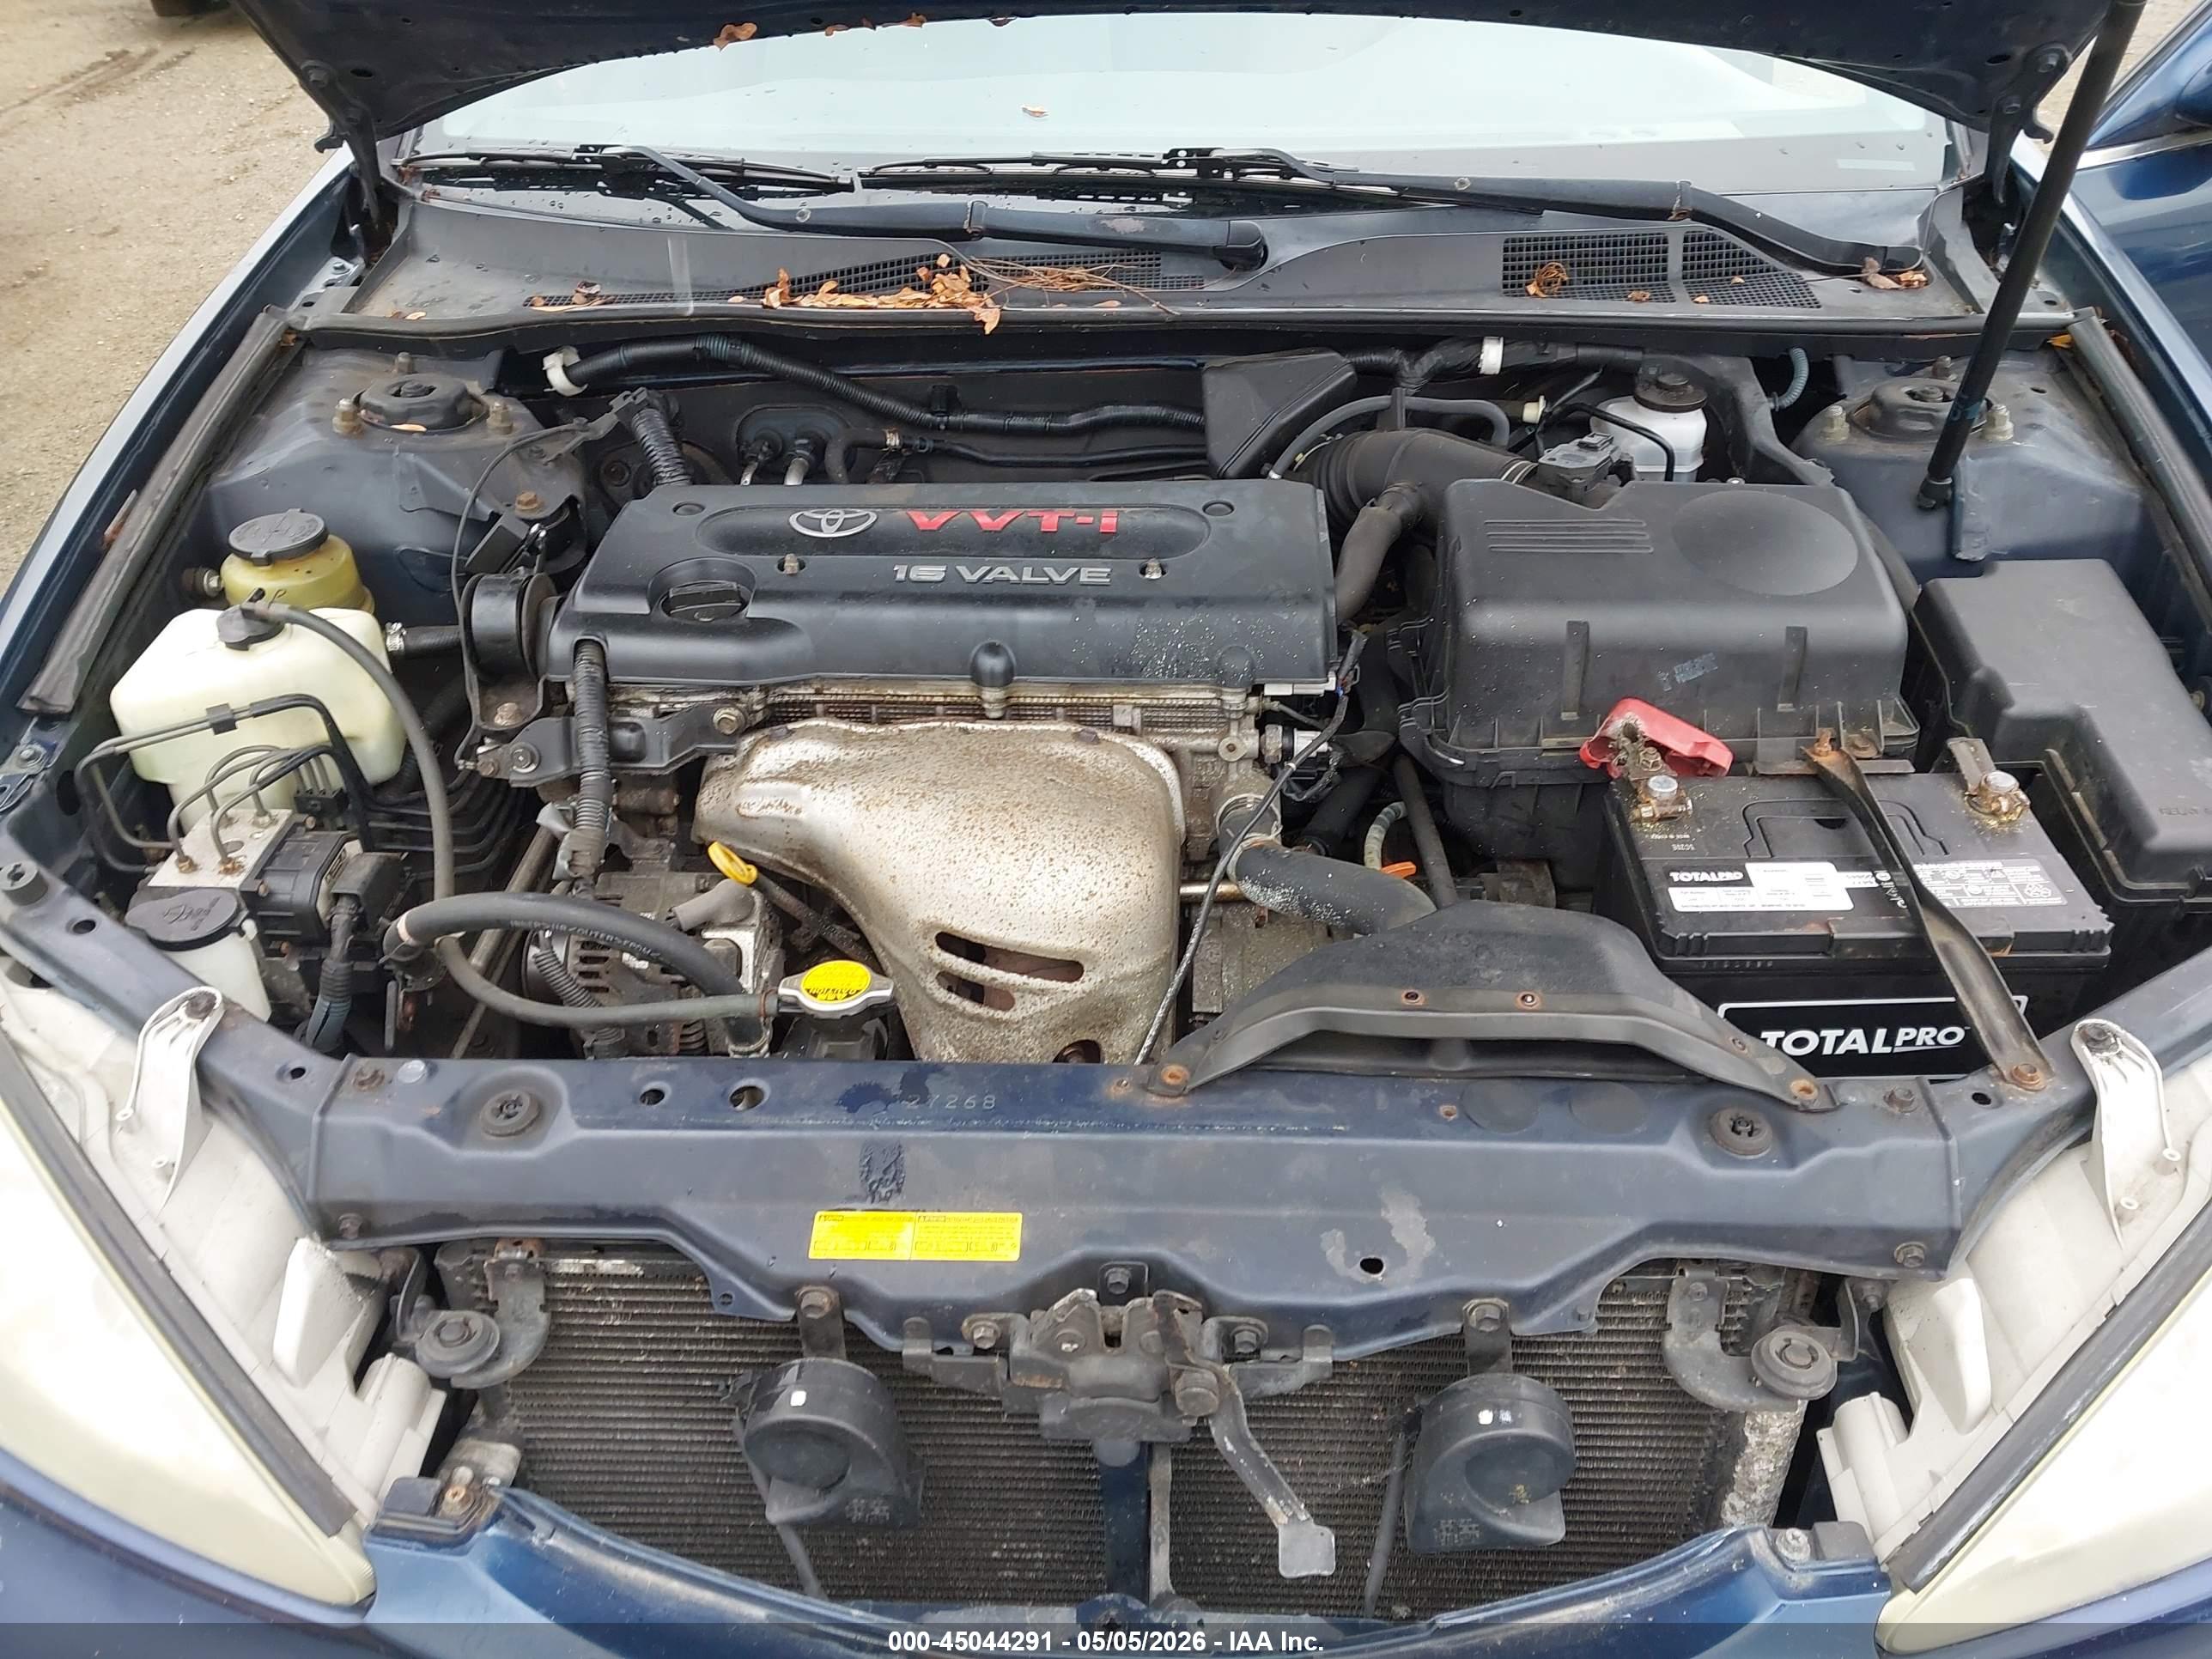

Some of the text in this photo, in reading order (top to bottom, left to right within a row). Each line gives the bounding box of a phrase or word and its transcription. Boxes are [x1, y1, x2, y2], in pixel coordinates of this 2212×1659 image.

[893, 564, 1112, 586] 16 VALVE
[1668, 871, 1744, 882] TOTALPRO
[1760, 1025, 1966, 1056] TOTALPRO
